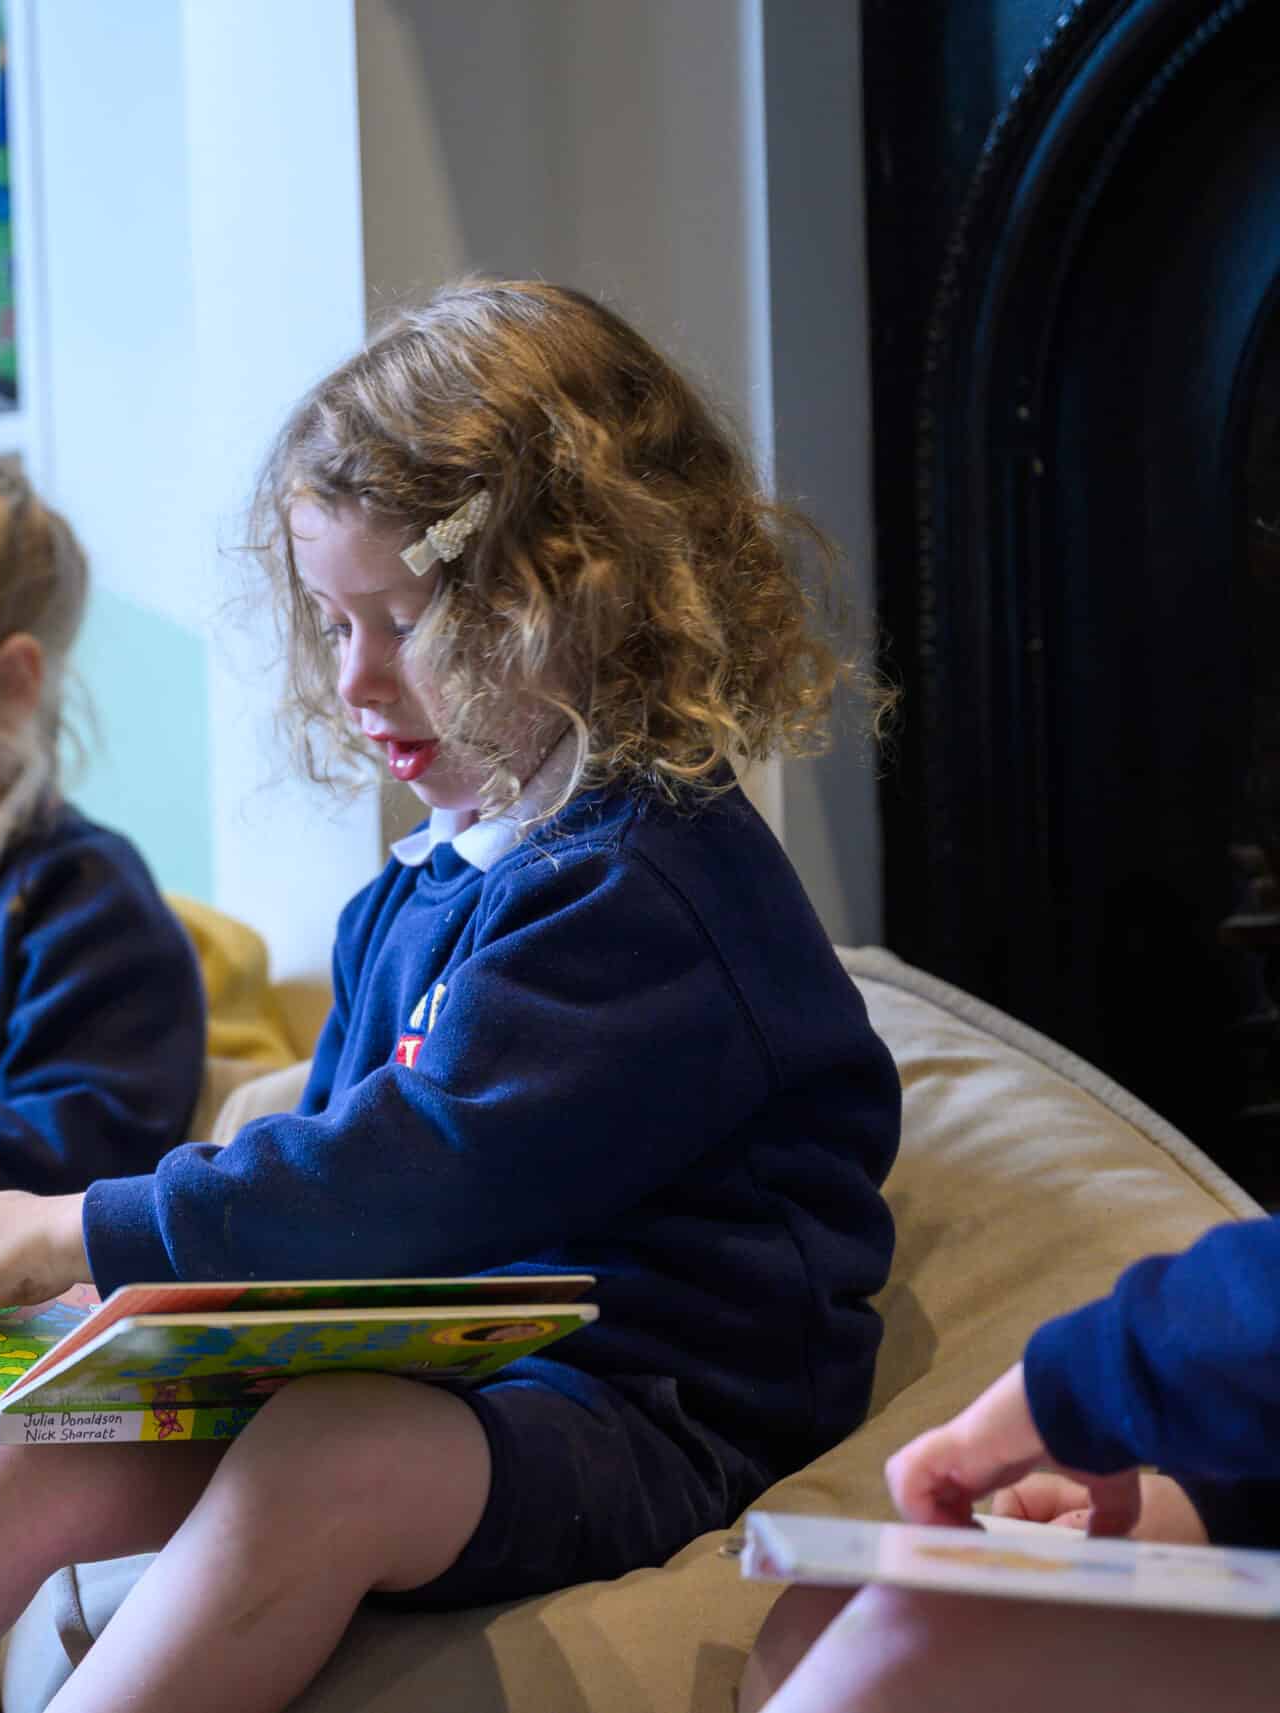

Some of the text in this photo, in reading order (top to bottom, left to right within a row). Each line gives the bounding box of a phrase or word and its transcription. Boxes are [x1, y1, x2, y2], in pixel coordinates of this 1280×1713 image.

[24, 1412, 122, 1427] Julia Donaldson
[25, 1428, 116, 1441] Nick Sharratt
